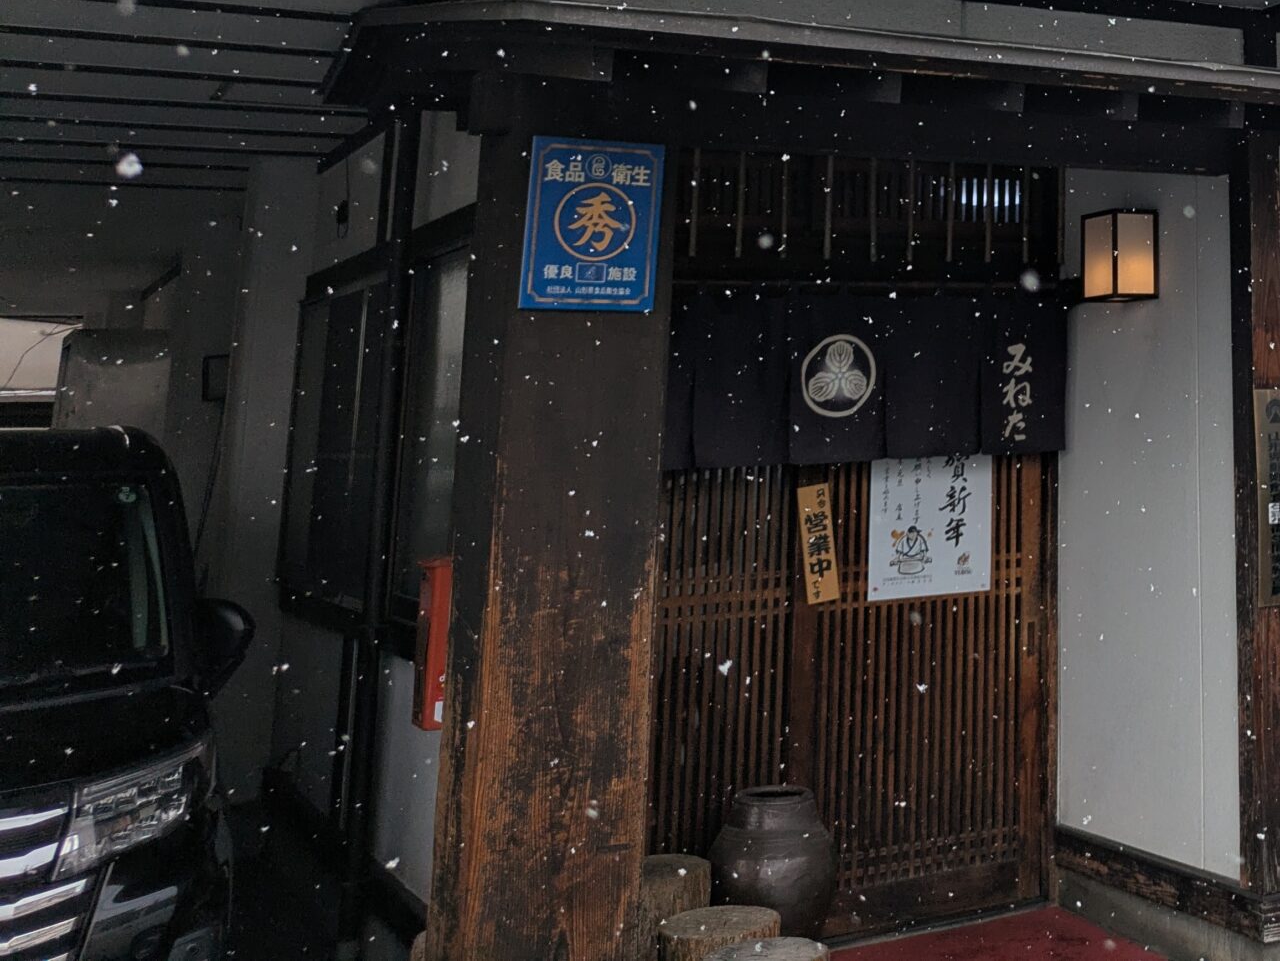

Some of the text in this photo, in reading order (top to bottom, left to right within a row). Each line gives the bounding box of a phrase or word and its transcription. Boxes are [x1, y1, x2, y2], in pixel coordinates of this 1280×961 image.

[543, 158, 652, 188] 食品 衛生
[567, 191, 624, 252] 秀
[543, 263, 638, 282] 優良 施設
[1001, 342, 1033, 442] みねた
[804, 487, 833, 601] 只今営業中です
